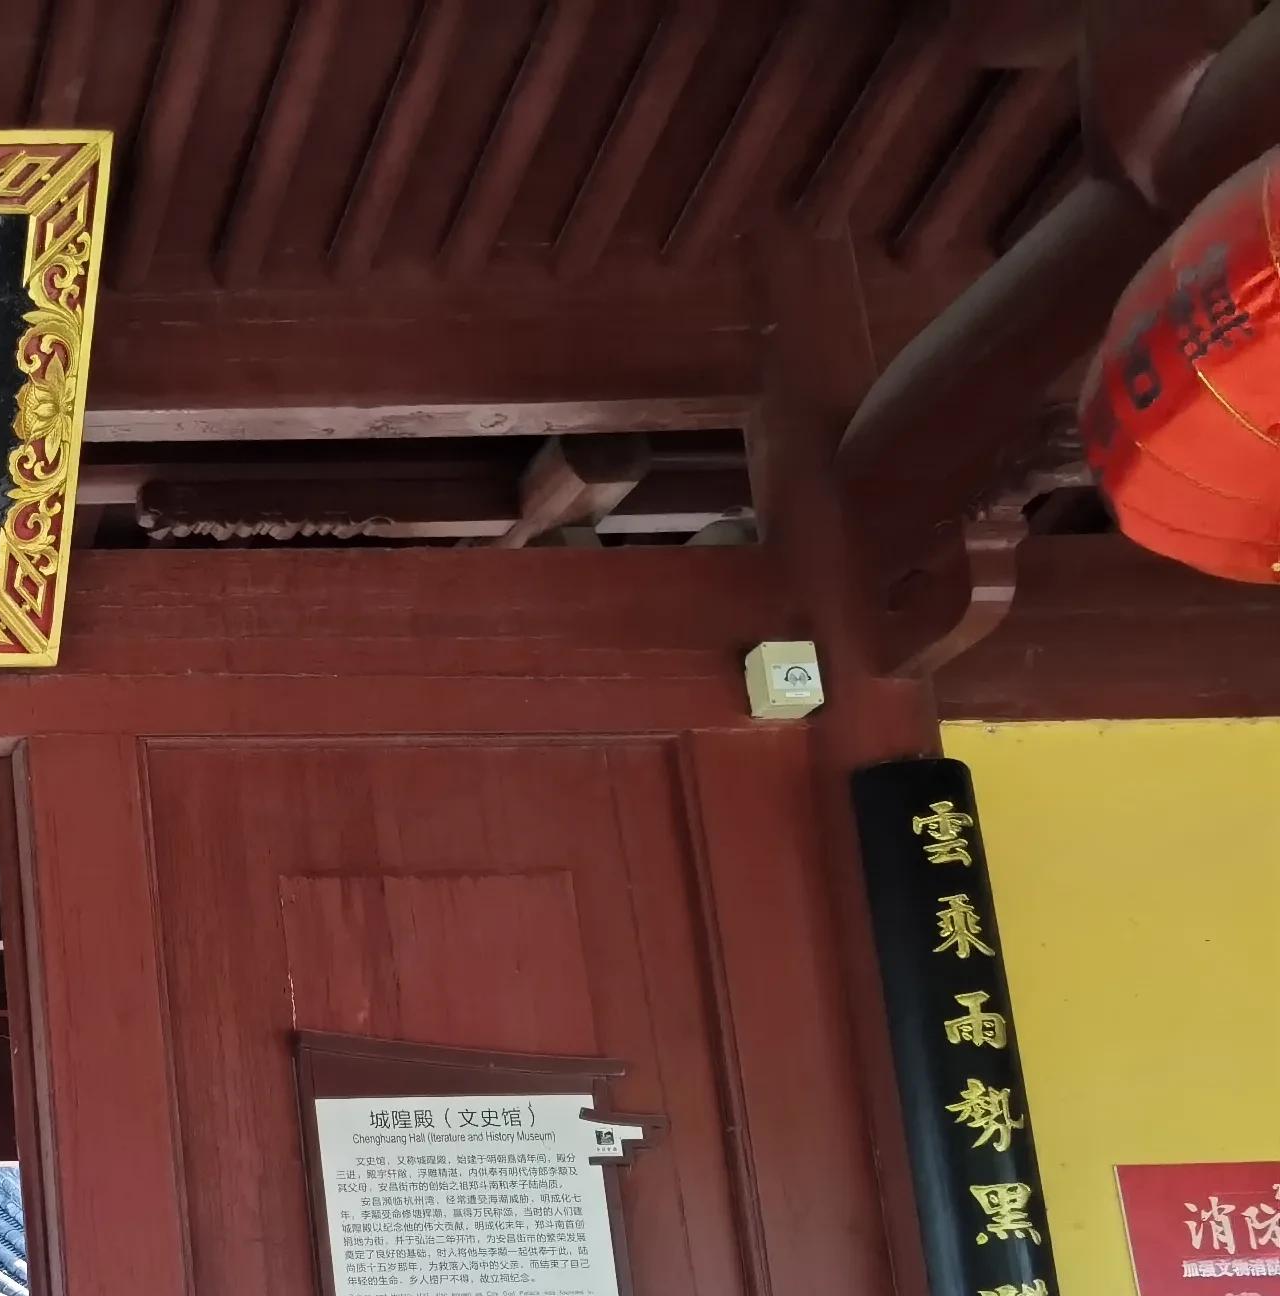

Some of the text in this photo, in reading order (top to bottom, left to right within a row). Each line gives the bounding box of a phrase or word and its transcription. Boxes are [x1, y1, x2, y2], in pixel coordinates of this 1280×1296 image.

[352, 1133, 407, 1146] Chenghuang
[408, 1132, 426, 1144] Hall
[485, 1131, 515, 1144] History
[516, 1130, 556, 1143] Museum)
